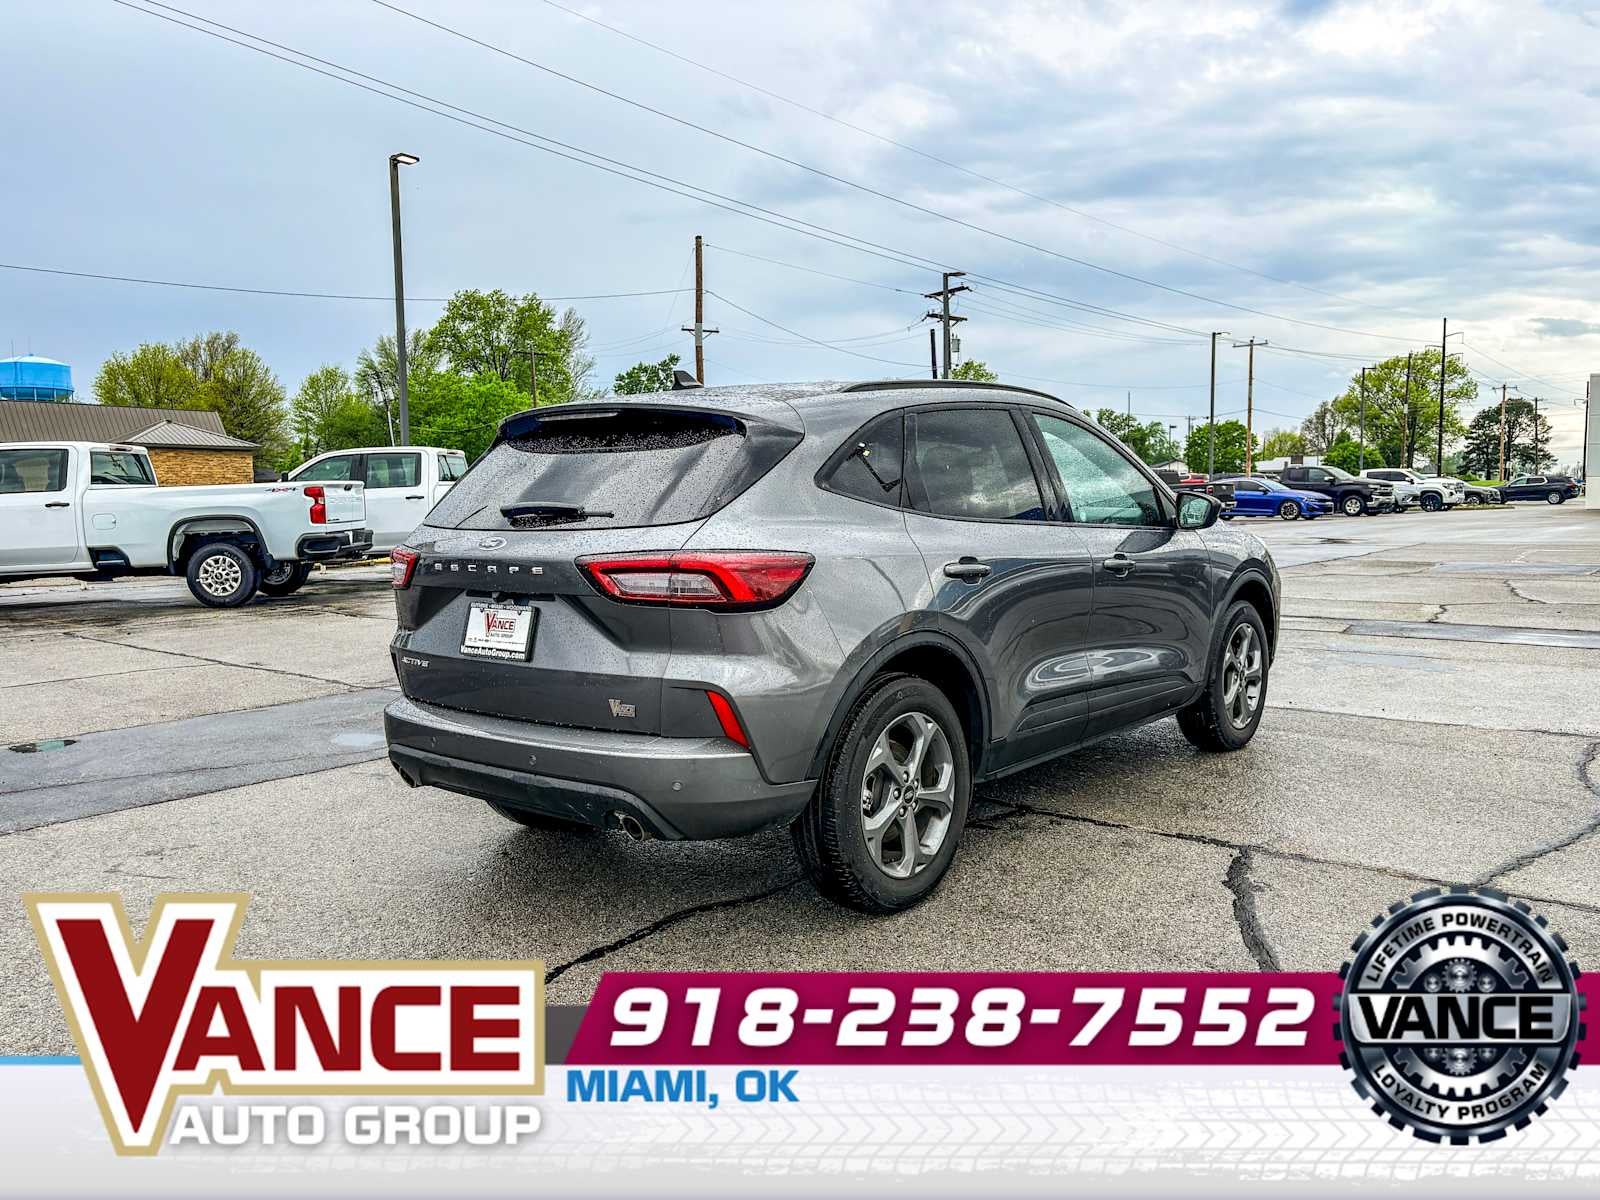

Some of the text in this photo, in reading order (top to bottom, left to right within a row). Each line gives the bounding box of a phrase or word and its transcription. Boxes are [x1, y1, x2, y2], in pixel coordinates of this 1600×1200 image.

[434, 562, 544, 575] ESCAPE
[486, 612, 515, 633] VANCE
[460, 645, 526, 660] VanceAutoGroup.com
